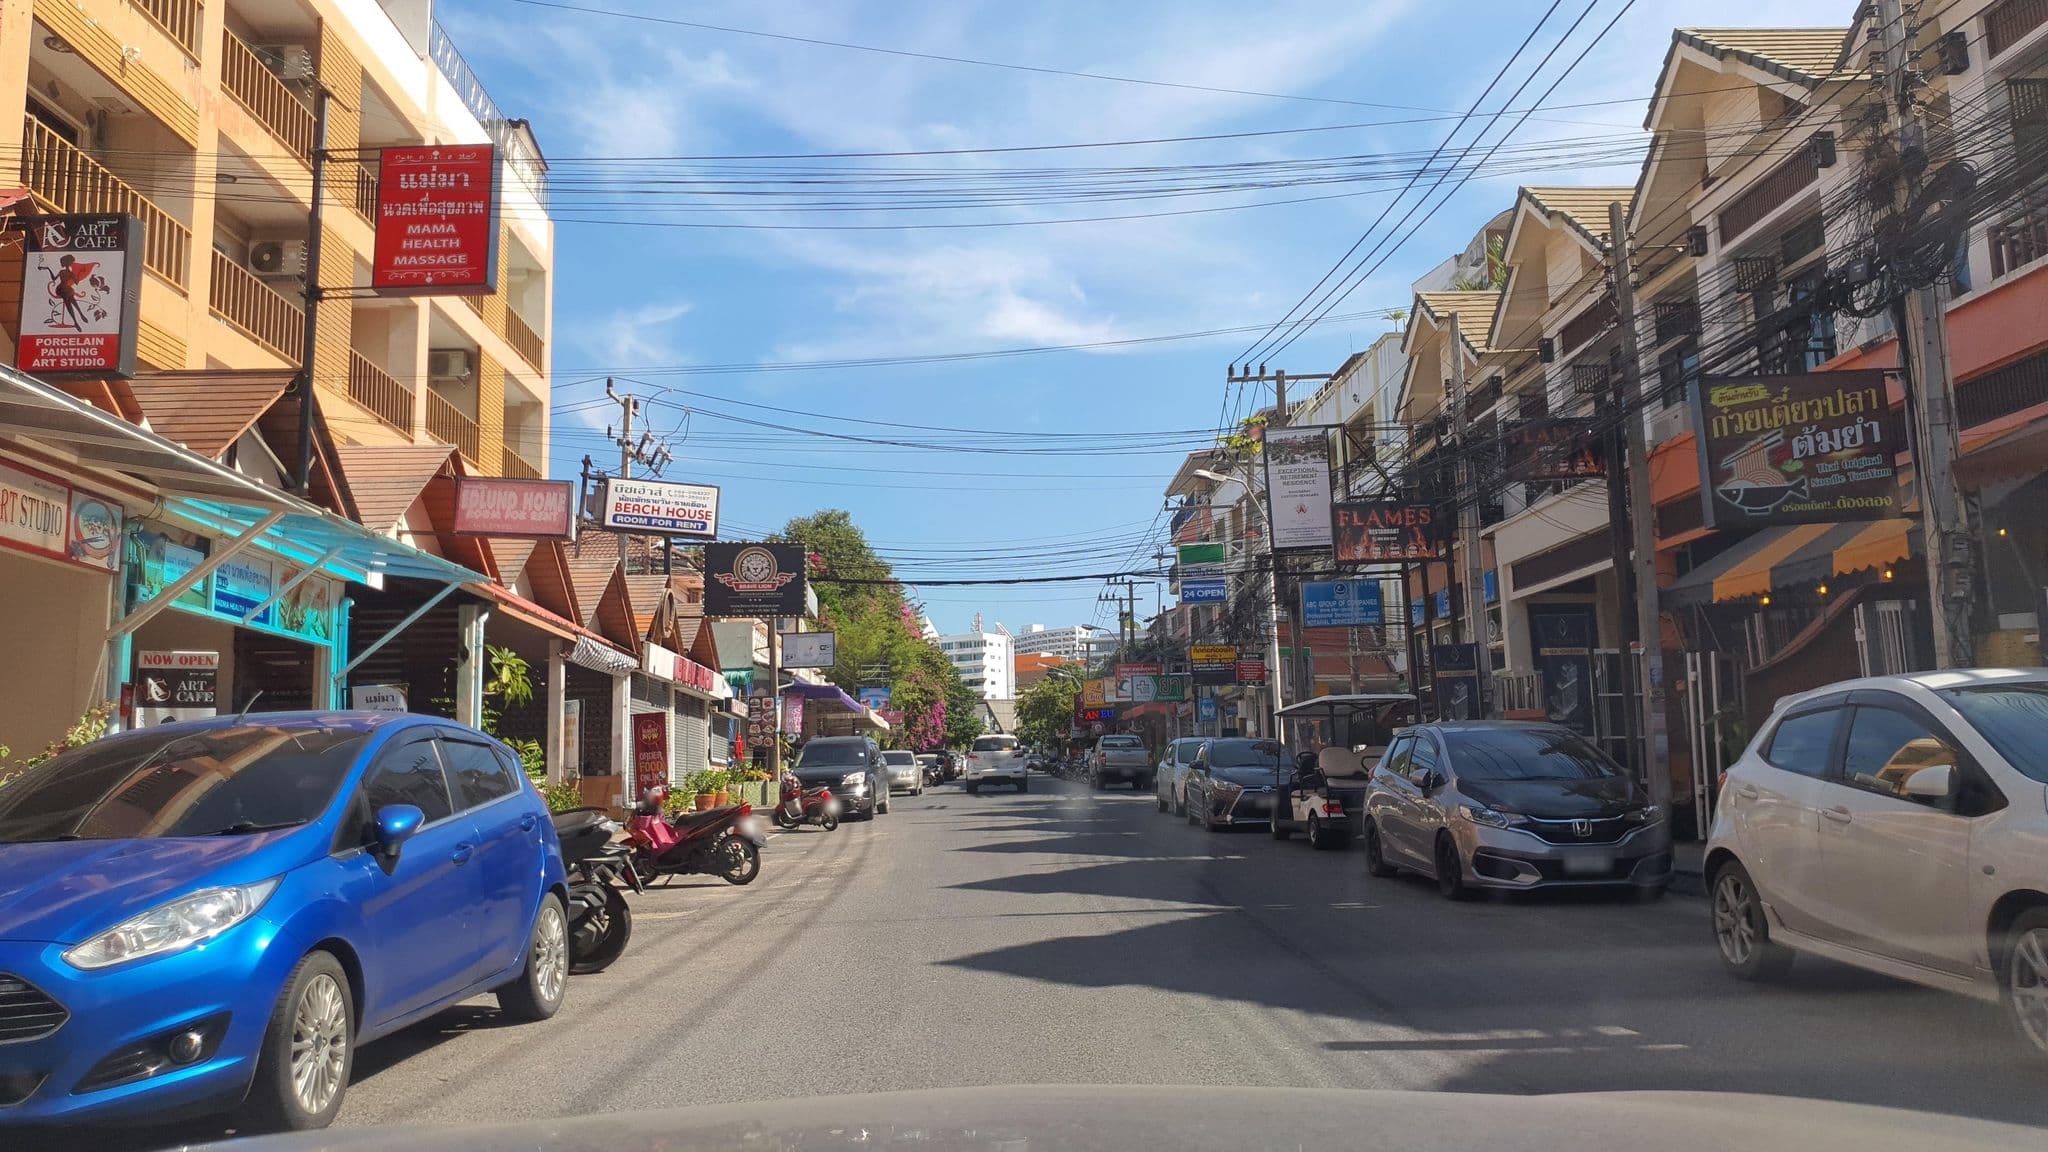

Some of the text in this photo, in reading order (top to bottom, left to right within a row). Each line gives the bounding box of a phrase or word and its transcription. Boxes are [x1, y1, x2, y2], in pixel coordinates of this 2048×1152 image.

[76, 223, 109, 236] ART
[407, 224, 456, 234] MAMA
[75, 236, 117, 249] CAFE
[402, 239, 460, 249] HEALTH
[393, 254, 468, 265] MASSAGE
[36, 337, 104, 346] PORCELAIN
[41, 347, 98, 356] PAINTING
[32, 358, 105, 367] ART STUDIO
[1712, 386, 1879, 438] ก๋วยเตี๋ยวปลา
[1791, 416, 1882, 459] ต้มยำ
[1816, 453, 1883, 473] Thai Original
[1811, 468, 1892, 487] Noodle TomYum
[522, 491, 567, 513] HOME
[0, 488, 62, 536] RT STUDIO
[614, 502, 712, 520] BEACH HOUSE
[617, 515, 704, 530] ROOM FOR RENT
[1338, 508, 1430, 528] FLAMES
[1184, 589, 1224, 598] 24 OPEN
[1318, 600, 1337, 608] GROUP
[1347, 598, 1377, 607] COMPANIES
[143, 654, 214, 666] NOW OPEN
[177, 681, 207, 691] ART
[1160, 677, 1182, 696] ยา
[176, 691, 214, 702] CAFE
[640, 751, 663, 760] ORDER
[640, 761, 665, 773] FOOD
